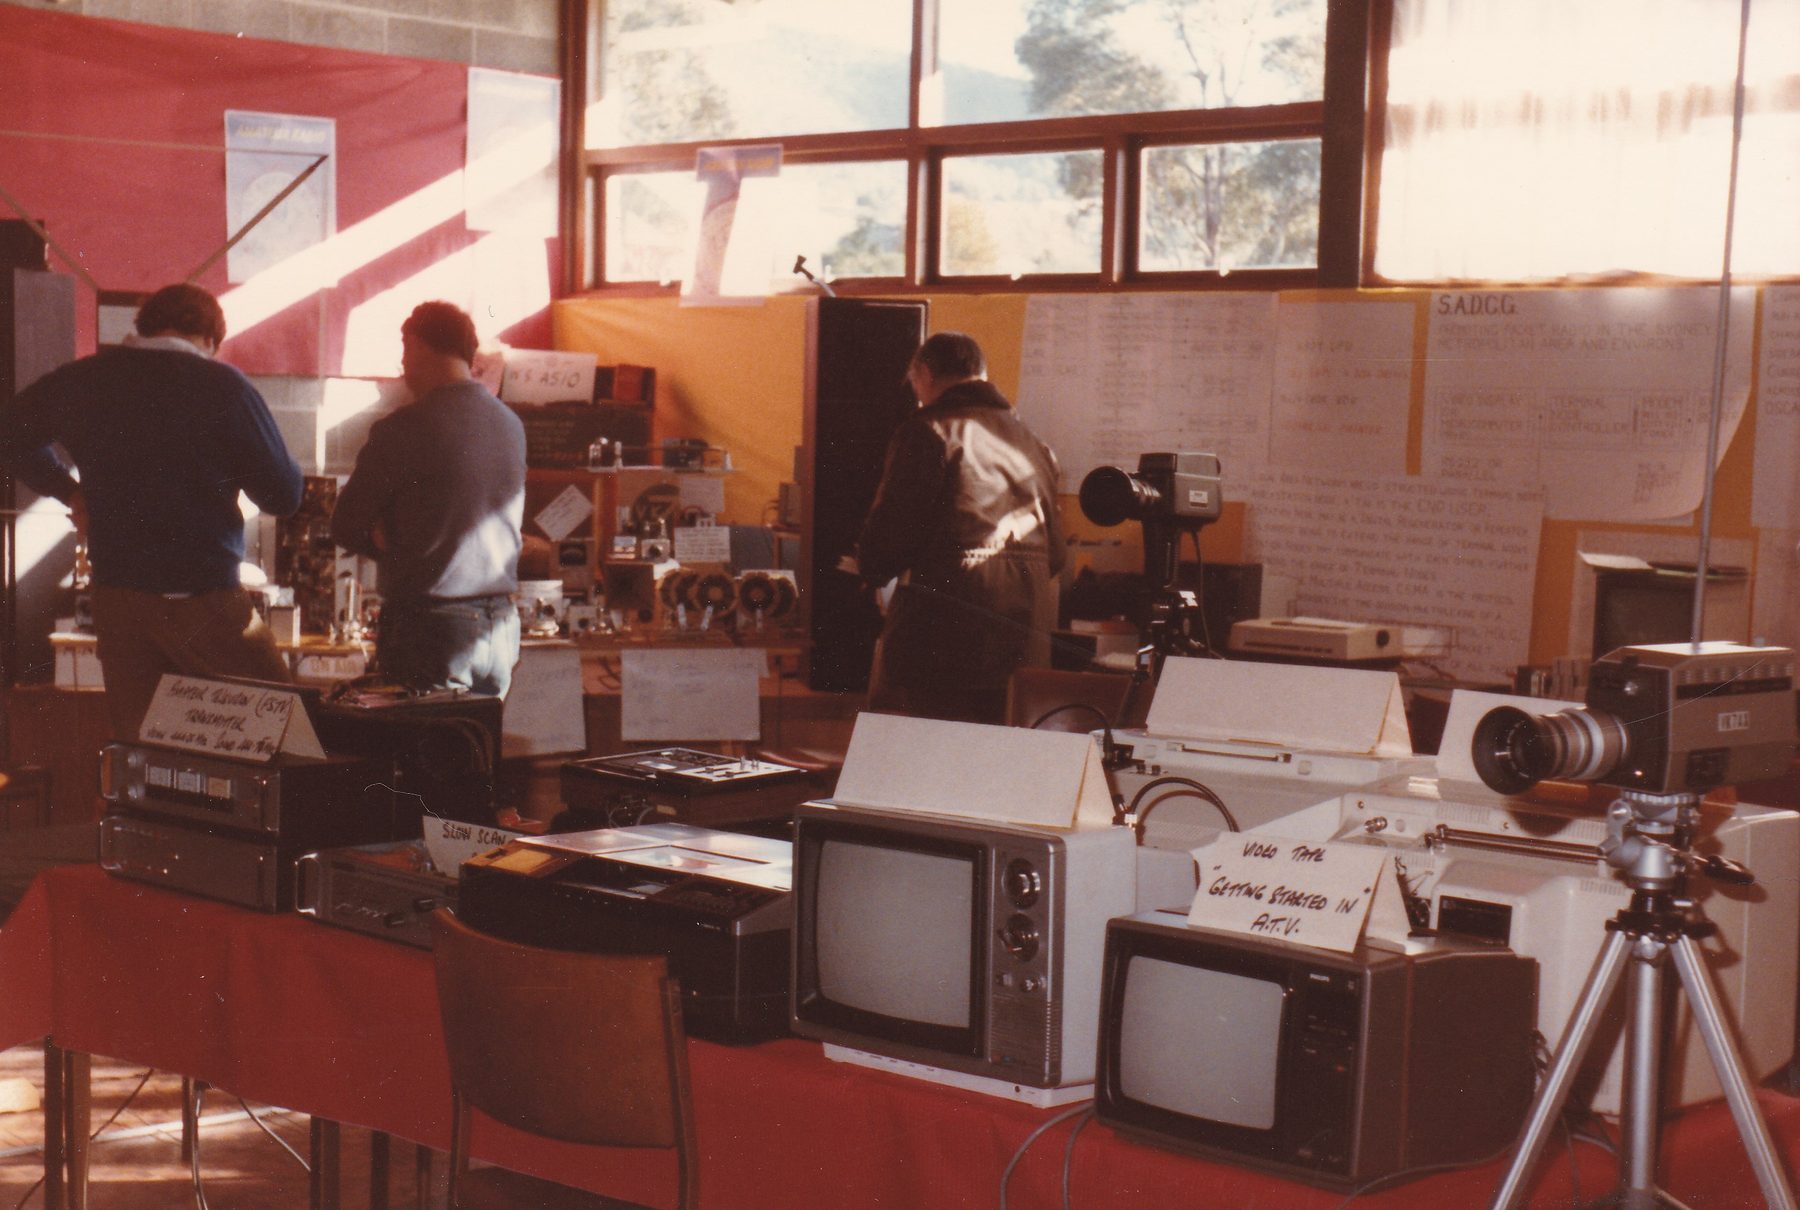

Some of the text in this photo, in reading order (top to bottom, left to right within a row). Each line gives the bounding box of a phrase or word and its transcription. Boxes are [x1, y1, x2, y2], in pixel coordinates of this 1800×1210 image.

[442, 822, 507, 846] SLOW SCAN
[1243, 841, 1327, 862] VIDEO TAPE
[1267, 885, 1328, 910] STARTED
